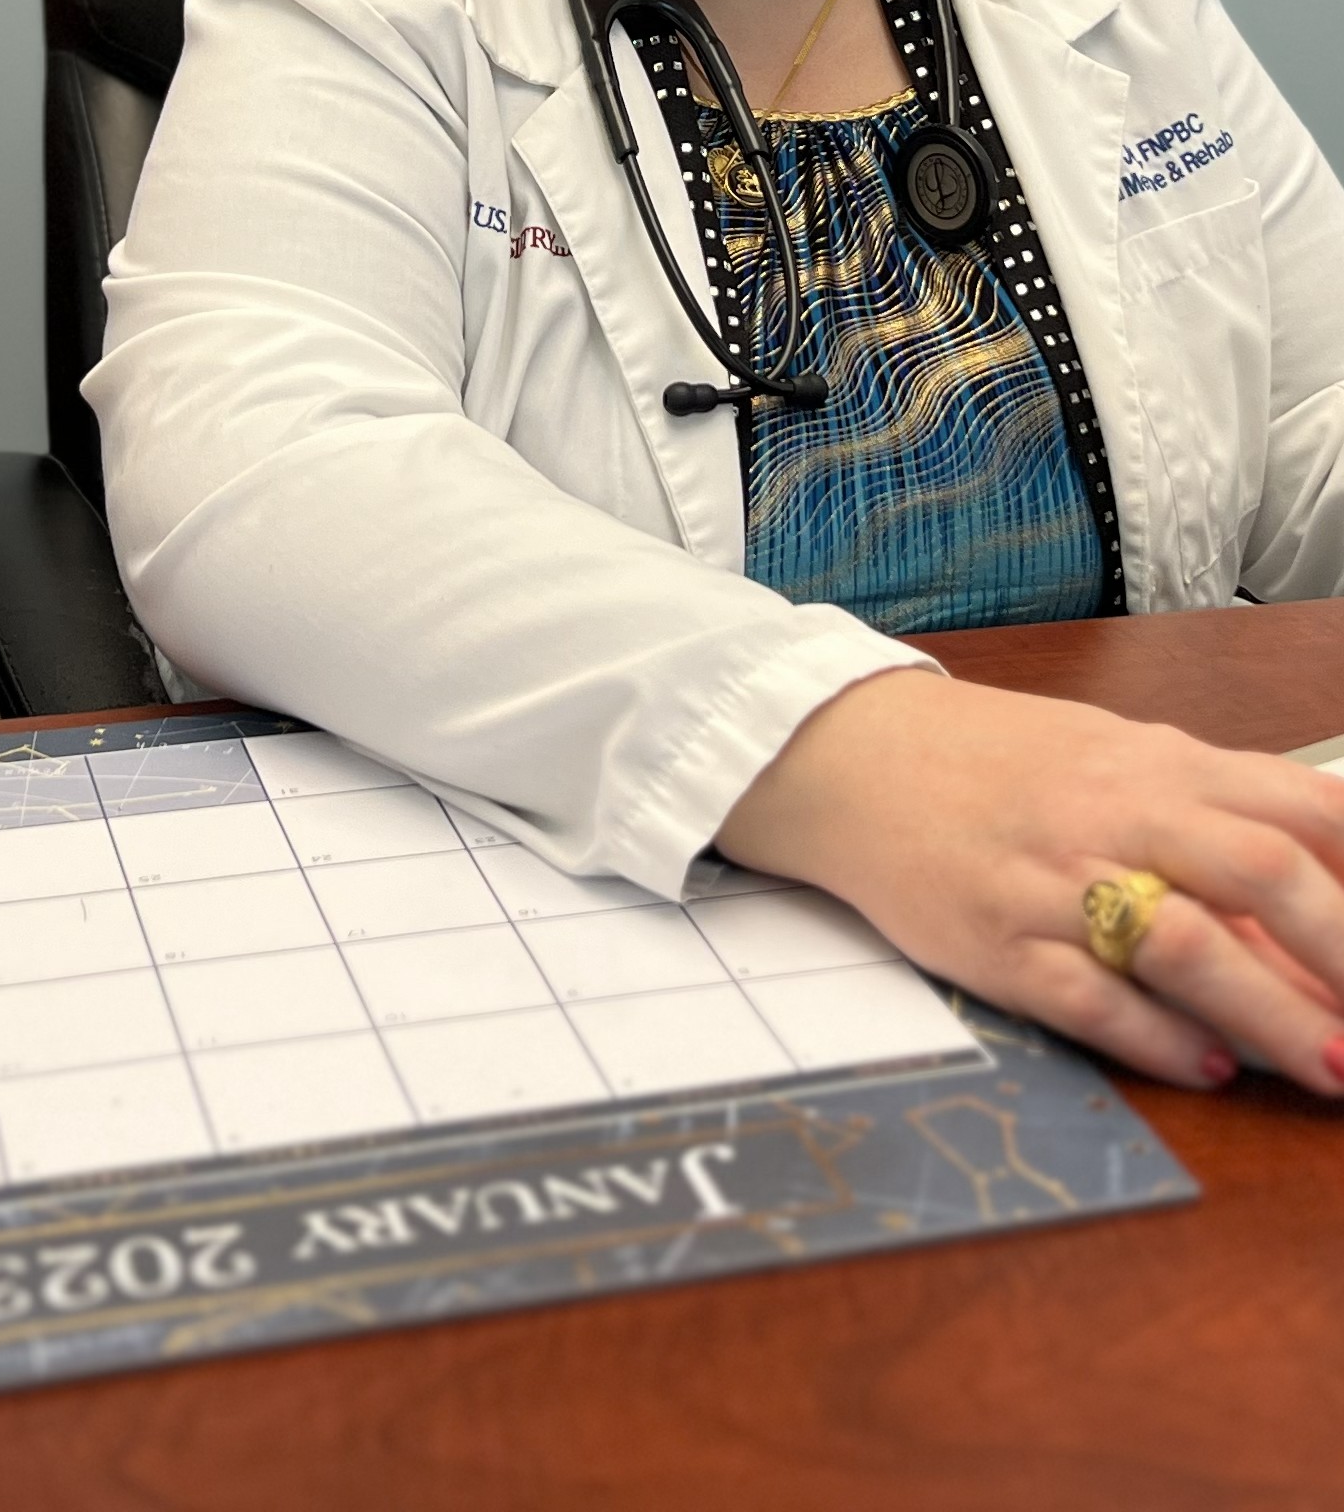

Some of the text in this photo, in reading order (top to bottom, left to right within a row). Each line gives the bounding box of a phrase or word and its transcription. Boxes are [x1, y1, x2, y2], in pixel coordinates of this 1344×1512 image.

[1165, 161, 1185, 182] &
[1179, 129, 1234, 173] Rehab
[292, 1142, 739, 1259] JANUARY
